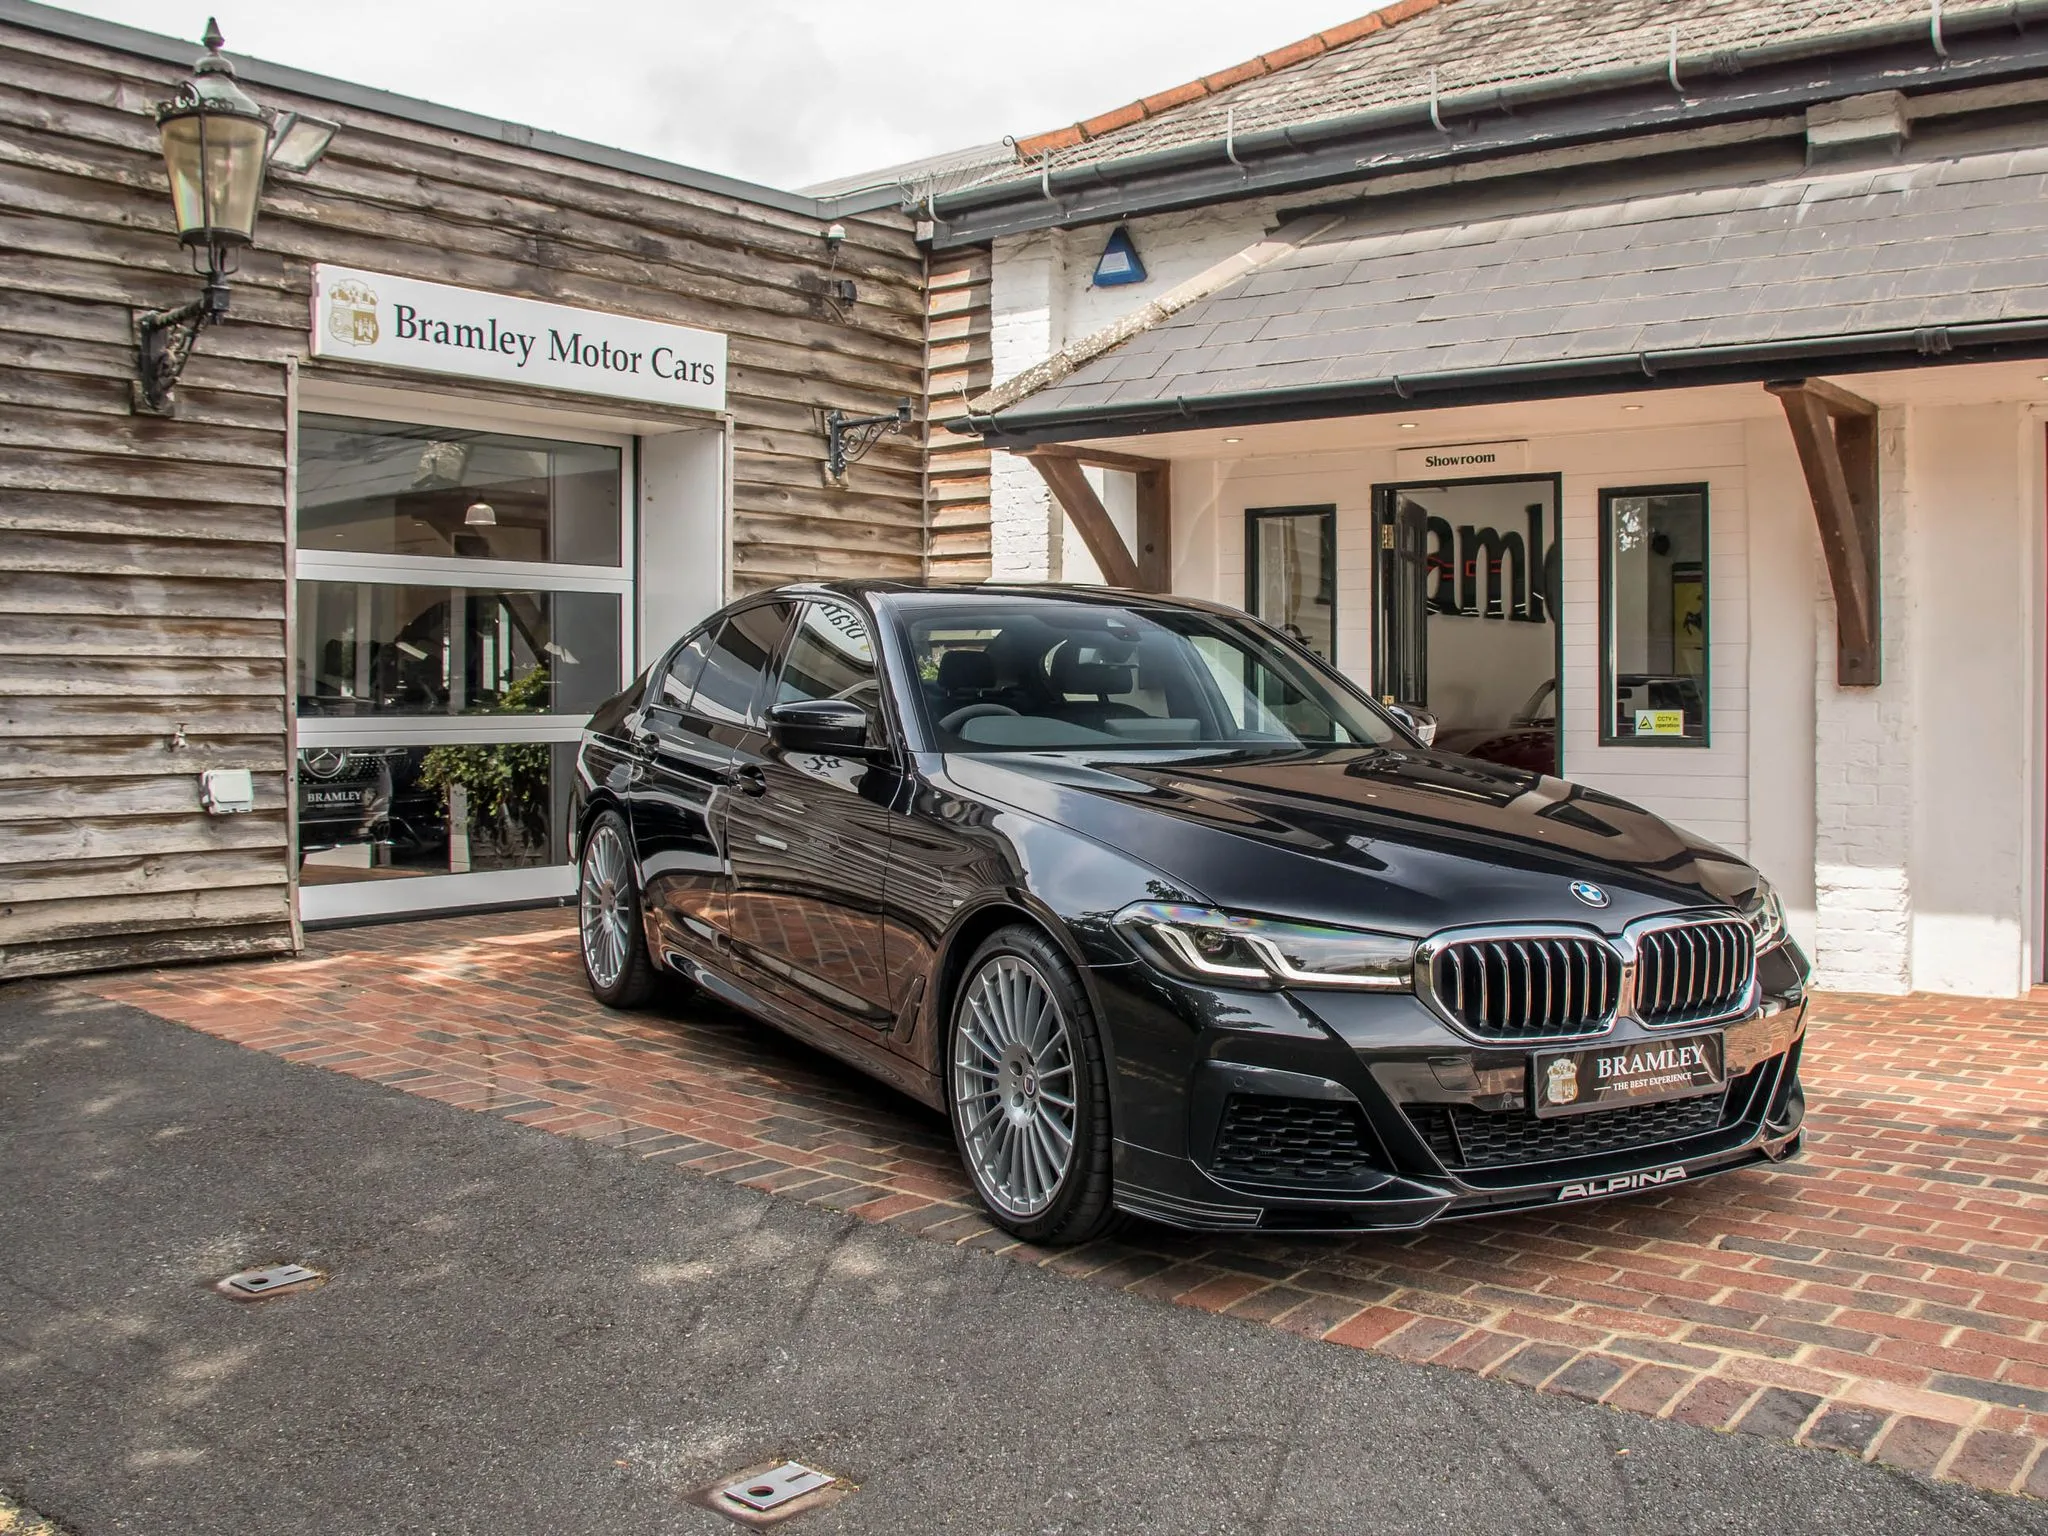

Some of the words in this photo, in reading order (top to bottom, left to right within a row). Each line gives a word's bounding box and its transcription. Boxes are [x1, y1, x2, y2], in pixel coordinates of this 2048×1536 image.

[393, 303, 536, 367] Bramley
[548, 328, 642, 374] Motor
[651, 347, 715, 385] Cars
[1425, 453, 1496, 468] Showroom
[307, 791, 361, 802] BRAMLEY
[1597, 1044, 1704, 1078] BRAMLEY
[1613, 1081, 1629, 1091] THE
[1630, 1078, 1648, 1089] BEST
[1649, 1072, 1692, 1086] EXPERIENCE
[1557, 1166, 1687, 1200] ALPINA
